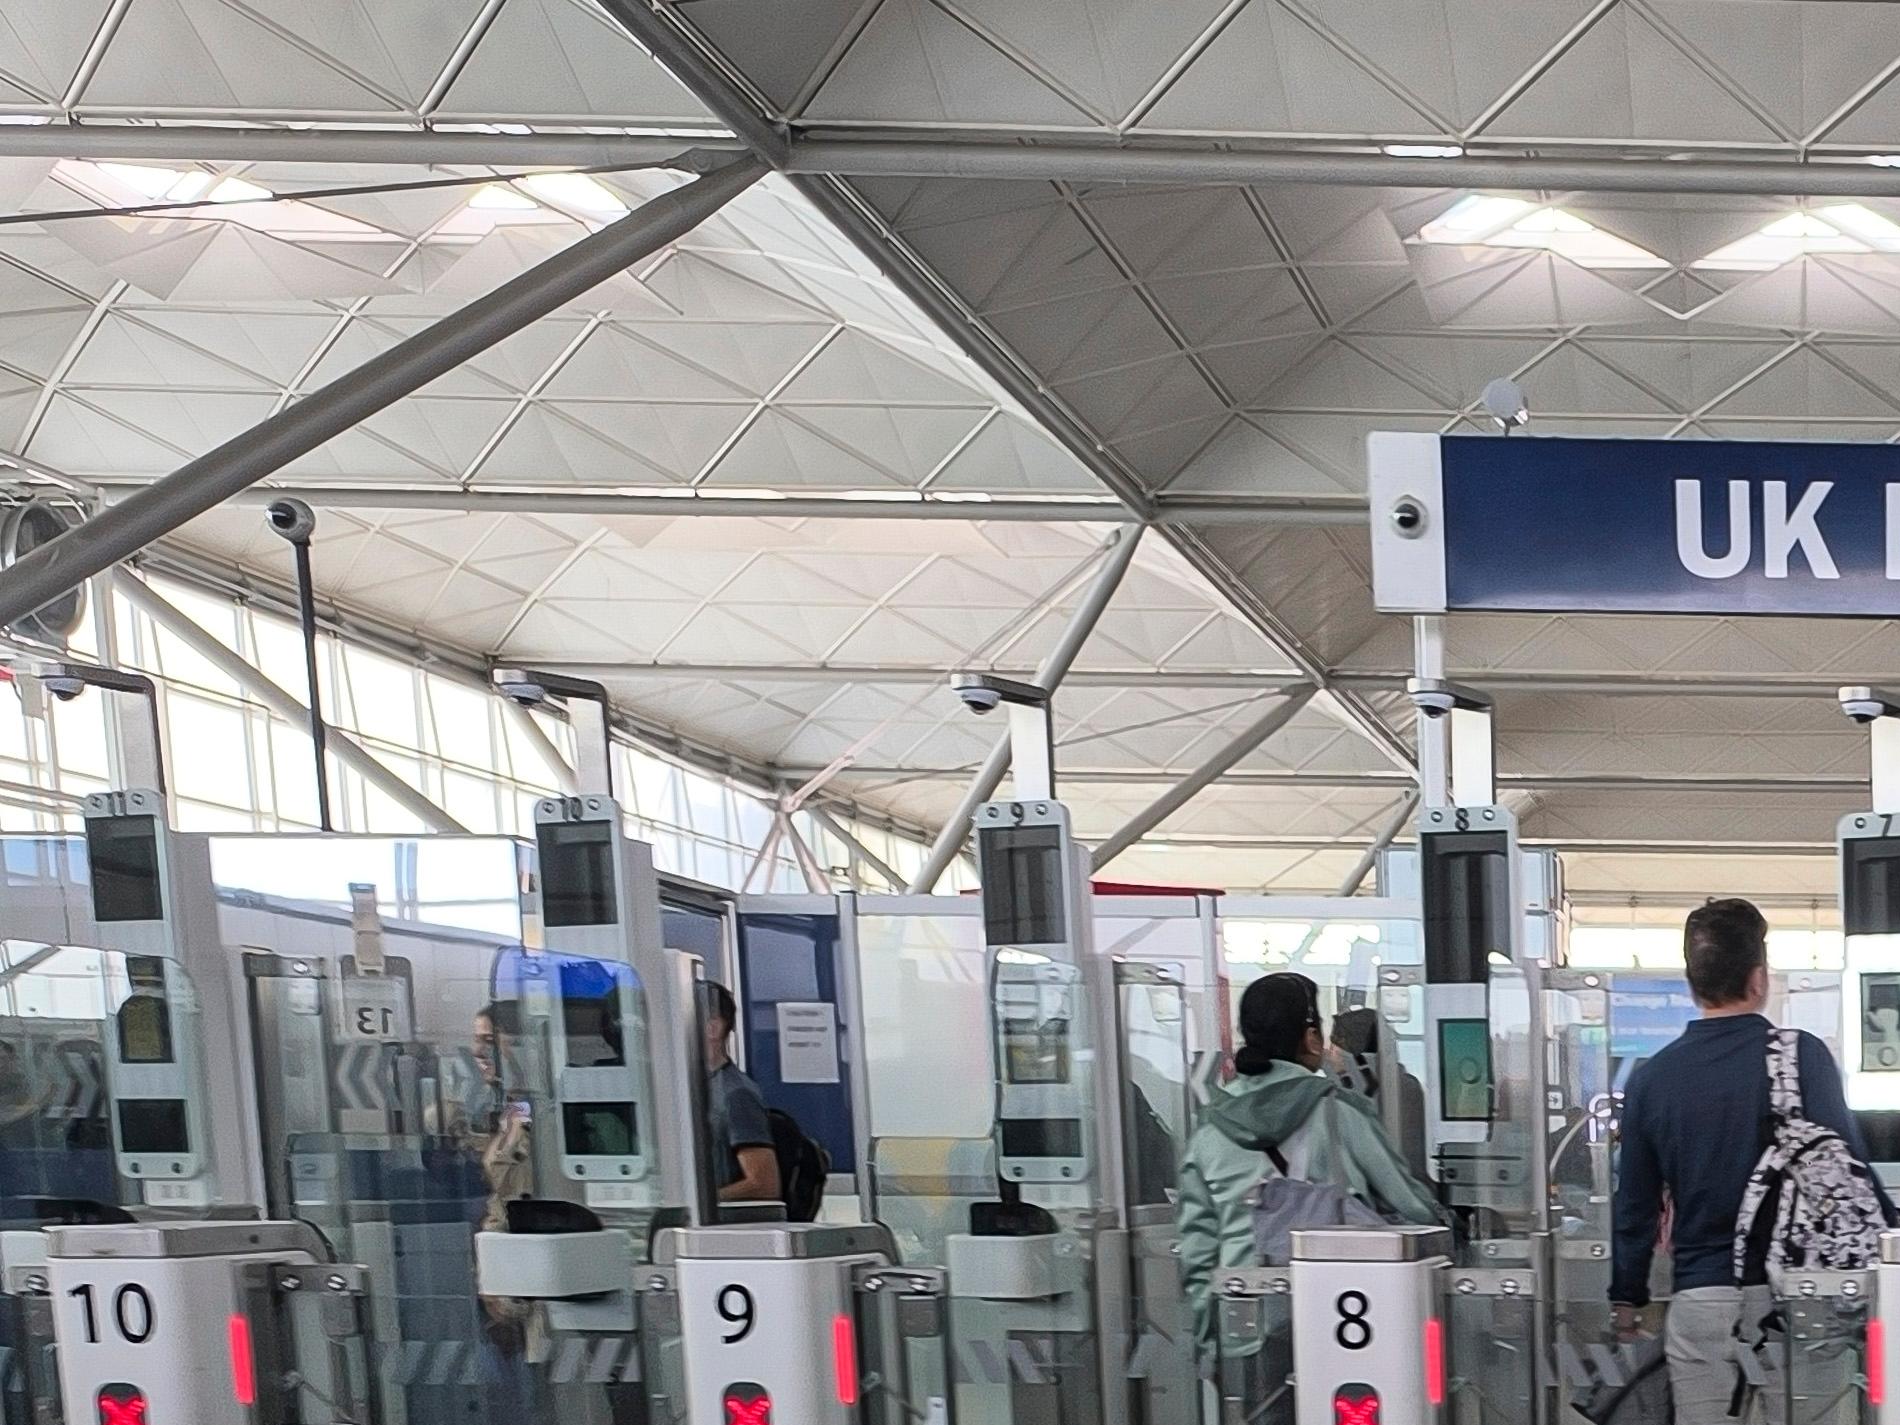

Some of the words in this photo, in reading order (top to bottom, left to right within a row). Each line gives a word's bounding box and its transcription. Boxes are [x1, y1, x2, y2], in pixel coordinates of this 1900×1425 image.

[1674, 478, 1840, 581] UK
[560, 796, 584, 821] 10
[1010, 803, 1025, 827] 9
[1454, 807, 1470, 831] 8
[1878, 814, 1893, 838] 7
[68, 1282, 153, 1344] 10
[717, 1283, 755, 1344] 9
[1335, 1290, 1372, 1350] 8
